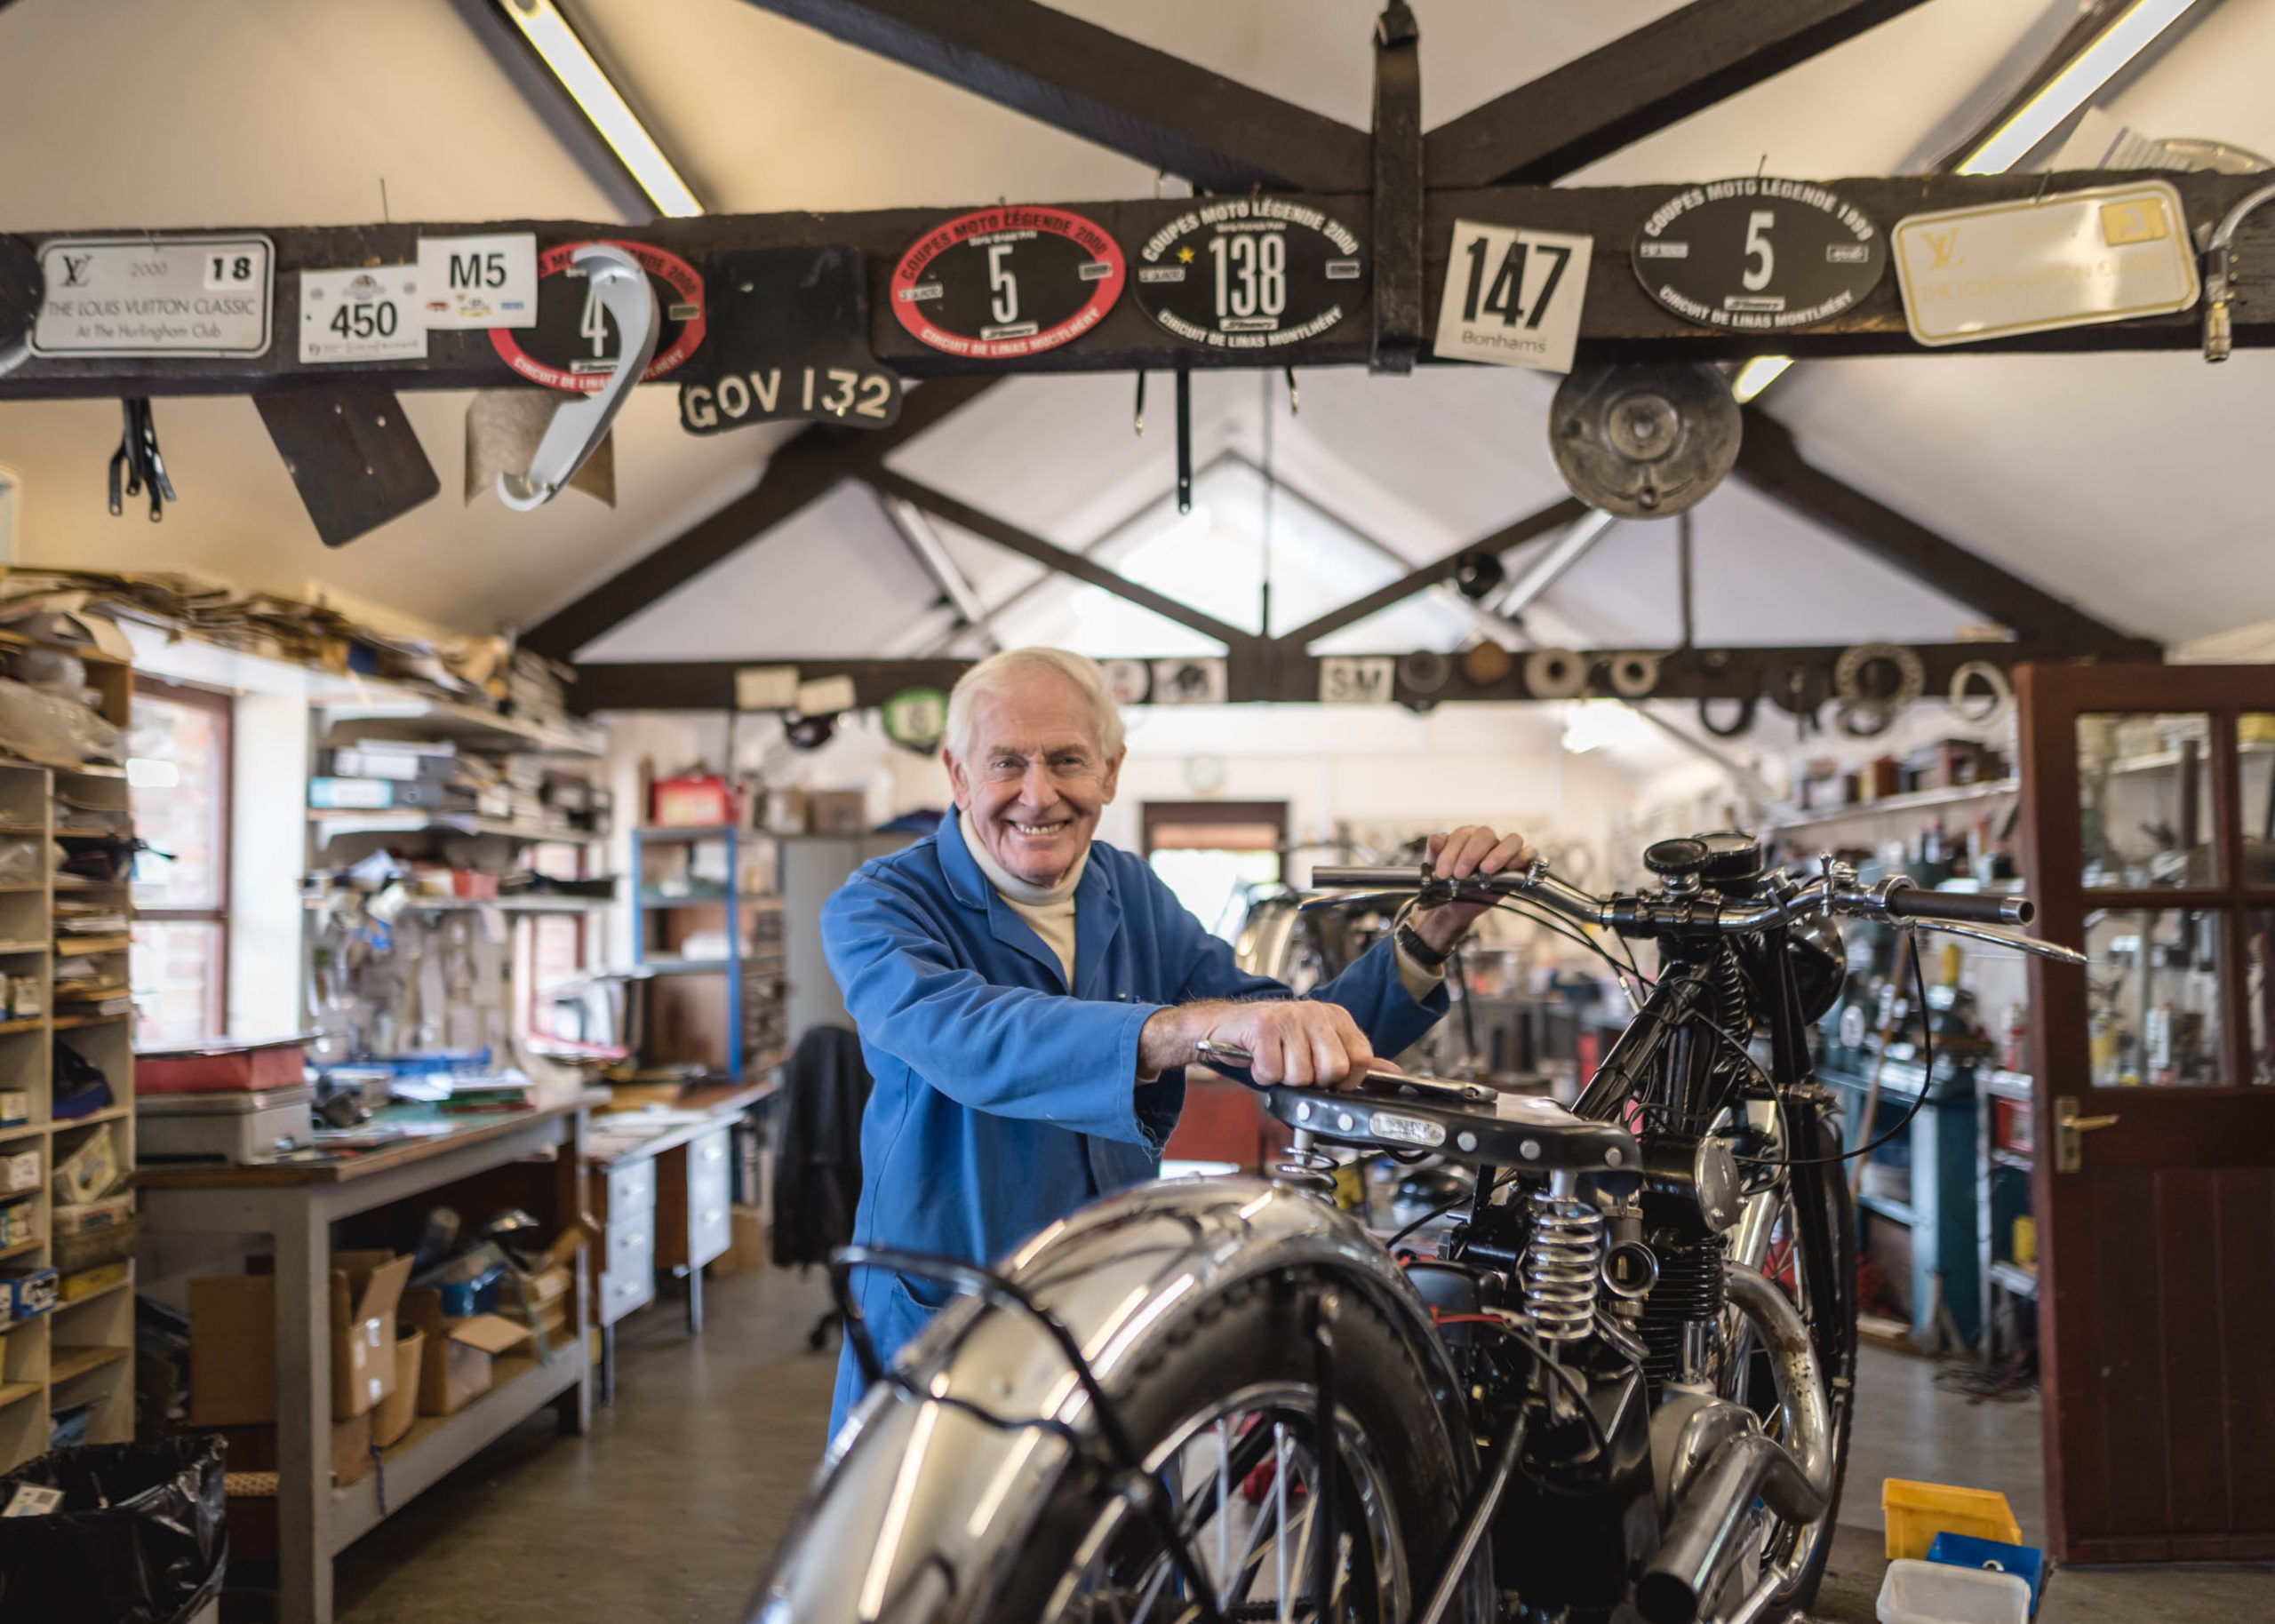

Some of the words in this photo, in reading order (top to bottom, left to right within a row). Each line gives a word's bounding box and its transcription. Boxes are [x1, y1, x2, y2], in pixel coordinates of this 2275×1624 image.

[1141, 213, 1201, 263] COUPES
[1200, 201, 1250, 225] MOTO
[1251, 197, 1328, 232] LÉGENDE
[1321, 219, 1360, 256] 2000
[1644, 187, 1705, 237] COUPES
[1705, 179, 1759, 201] MOTO
[1836, 202, 1875, 242] 1999
[2120, 205, 2145, 235] 3
[900, 233, 953, 281] COUPES
[953, 216, 1000, 239] MOTO
[1002, 209, 1073, 235] LÉGENDE
[1074, 226, 1109, 256] 2000
[1742, 210, 1775, 291] 5
[450, 252, 507, 290] M5
[987, 243, 1019, 323] 5
[1208, 234, 1287, 318] 138
[1462, 236, 1572, 330] 147
[48, 300, 74, 316] THE
[78, 299, 122, 315] LOUIS
[125, 299, 191, 314] VUITTON
[194, 299, 256, 315] CLASSIC
[330, 300, 398, 338] 450
[580, 289, 608, 357] 4
[1157, 307, 1209, 344] CIRCUIT
[1208, 331, 1226, 347] DE
[1227, 332, 1266, 348] LINAS
[1267, 305, 1344, 346] MONTLHÉRY
[1658, 284, 1711, 321] CIRCUIT
[1711, 309, 1730, 326] DE
[1732, 311, 1772, 329] LINAS
[94, 323, 115, 338] The
[118, 323, 188, 342] Hurlingham
[192, 322, 221, 338] Club
[921, 326, 970, 354] CIRCUIT
[970, 339, 988, 355] DE
[989, 339, 1029, 356] LINAS
[1462, 330, 1547, 354] Bonhams
[514, 357, 558, 385] CIRCUIT
[560, 376, 577, 388] DE
[683, 366, 775, 426] GOV
[801, 365, 891, 418] 132
